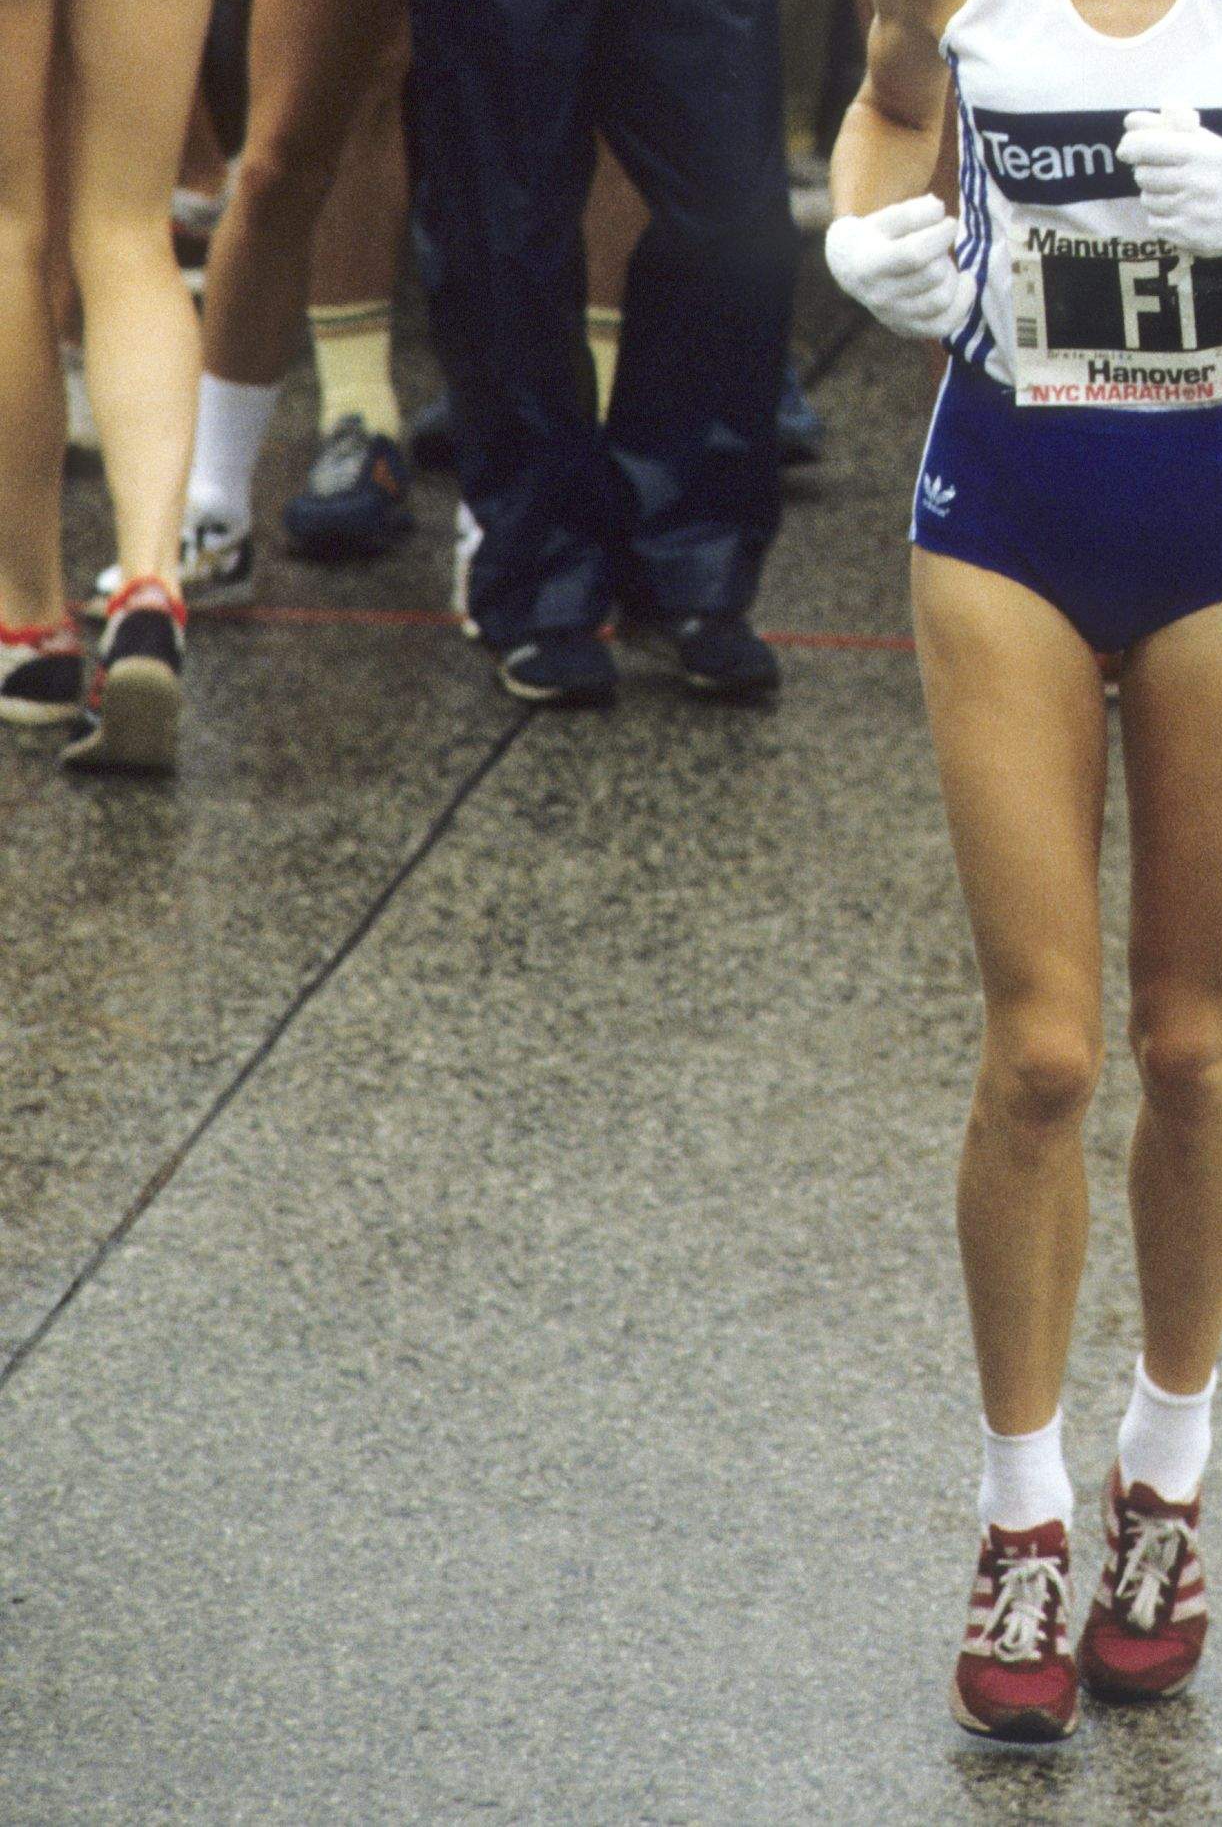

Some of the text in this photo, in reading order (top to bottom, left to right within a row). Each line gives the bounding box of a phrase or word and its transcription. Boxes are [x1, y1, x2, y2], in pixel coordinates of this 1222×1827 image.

[982, 130, 1115, 181] Team
[1026, 227, 1178, 259] Manufact
[1118, 256, 1198, 351] F1
[1087, 359, 1215, 385] Hanover
[1031, 384, 1080, 402] NYC
